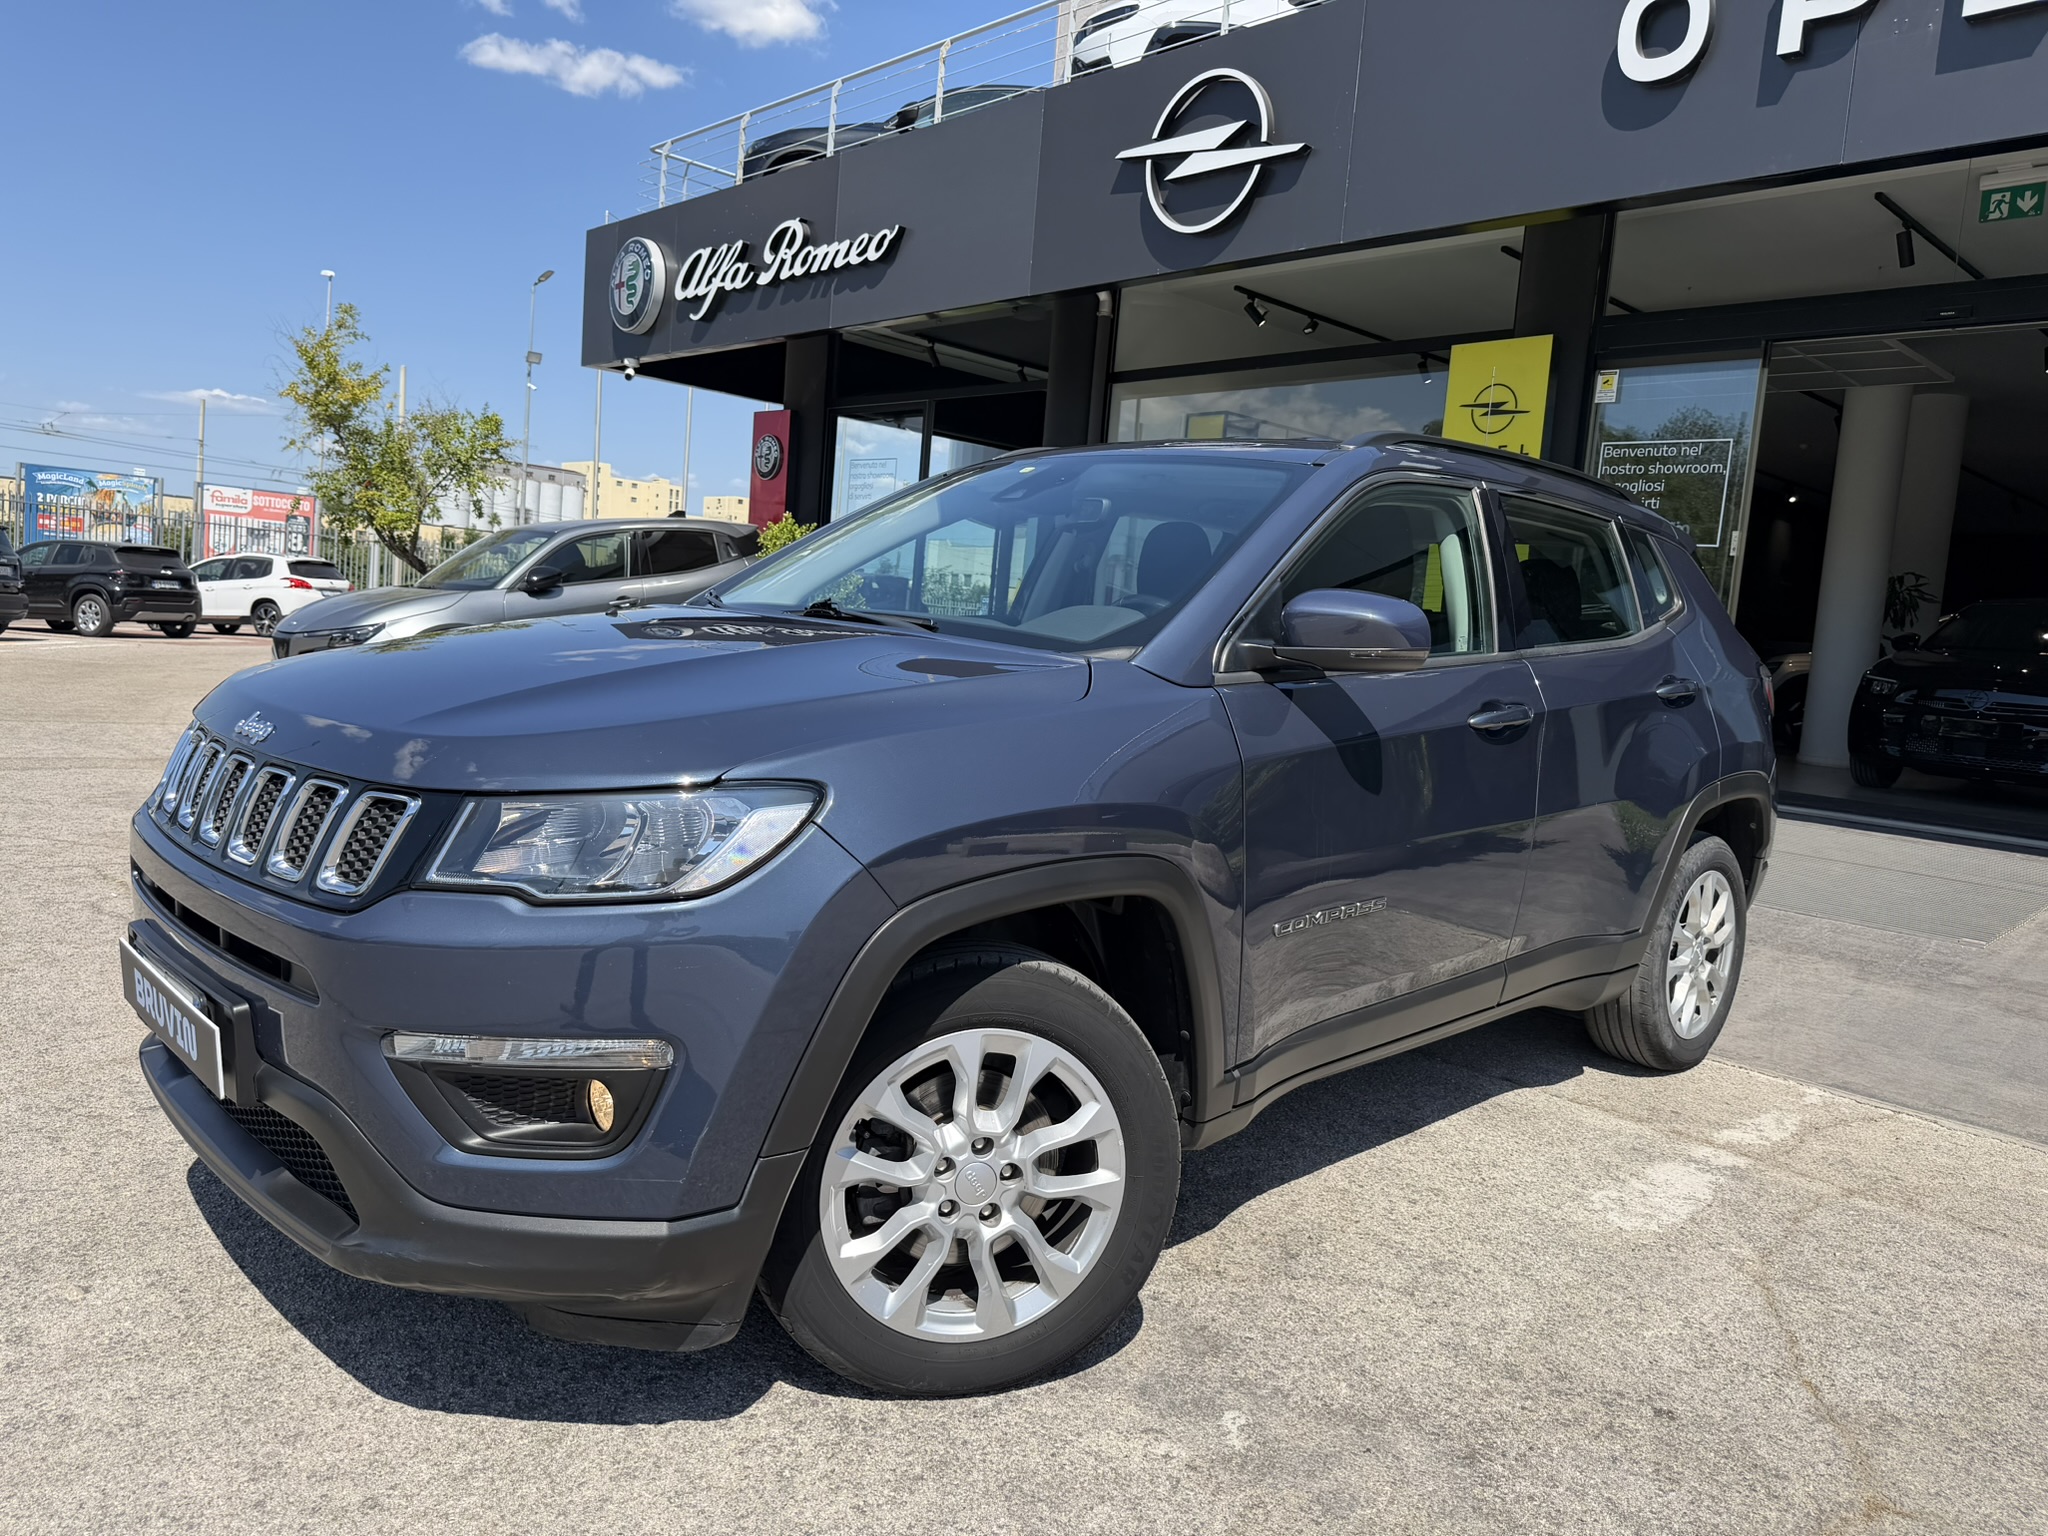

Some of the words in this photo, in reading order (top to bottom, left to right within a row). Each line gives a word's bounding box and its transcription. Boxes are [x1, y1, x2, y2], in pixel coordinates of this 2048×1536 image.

[628, 243, 652, 281] ROMEO
[674, 239, 755, 321] Alfa
[756, 218, 900, 286] Romeo
[1603, 445, 1677, 458] Benvenuto
[1681, 442, 1703, 456] nel
[1601, 463, 1645, 475] nostro
[1648, 461, 1727, 475] showroom,
[1615, 479, 1666, 495] ogliosi
[37, 492, 44, 503] 2
[253, 495, 311, 512] SOTTOCTO
[1273, 896, 1387, 938] COMPASS
